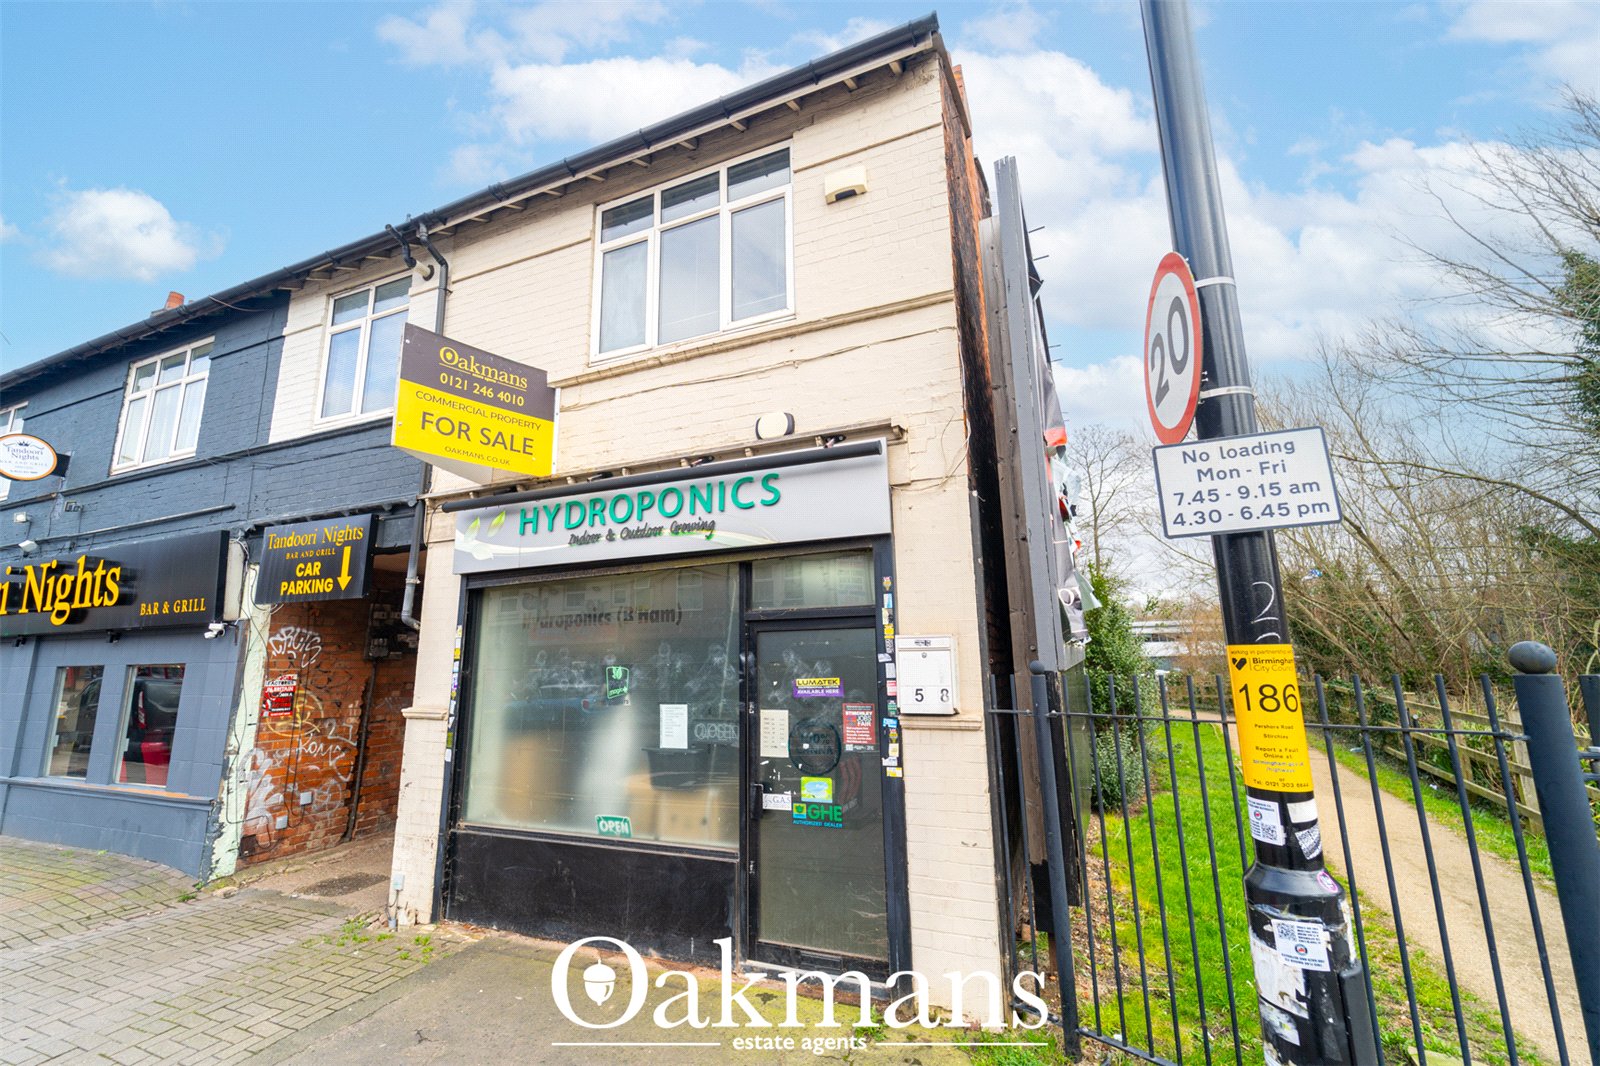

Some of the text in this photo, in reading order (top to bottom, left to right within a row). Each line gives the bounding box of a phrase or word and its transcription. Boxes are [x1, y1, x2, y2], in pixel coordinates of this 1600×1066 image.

[1150, 295, 1190, 409] 20
[439, 346, 528, 389] Oakmans
[439, 372, 525, 407] 0121 246 4010
[415, 390, 542, 431] COMMERCIAL PROPERTY
[420, 411, 535, 456] FOR SALE
[1182, 439, 1296, 465] No loading
[1196, 466, 1241, 482] Mon
[1260, 460, 1287, 476] Fri
[519, 473, 781, 535] HYDROPONICS
[1173, 488, 1220, 506] 7.45
[1237, 482, 1282, 500] 9.15
[1289, 480, 1321, 495] am
[1172, 509, 1222, 527] 4.30
[1240, 502, 1291, 520] 6.45
[1297, 501, 1331, 518] pm
[268, 524, 364, 550] Tandoori Nights
[568, 517, 716, 546] Indoor & Outdoor Growing
[285, 548, 336, 560] BAR AND GRILL
[295, 561, 322, 577] CAR
[19, 554, 121, 626] Nights
[280, 577, 334, 596] PARKING
[140, 598, 207, 616] BAR & GRILL
[1253, 665, 1270, 673] City
[914, 688, 924, 702] 5
[1238, 683, 1299, 713] 186
[807, 803, 843, 822] GHE
[599, 820, 630, 834] OPEN
